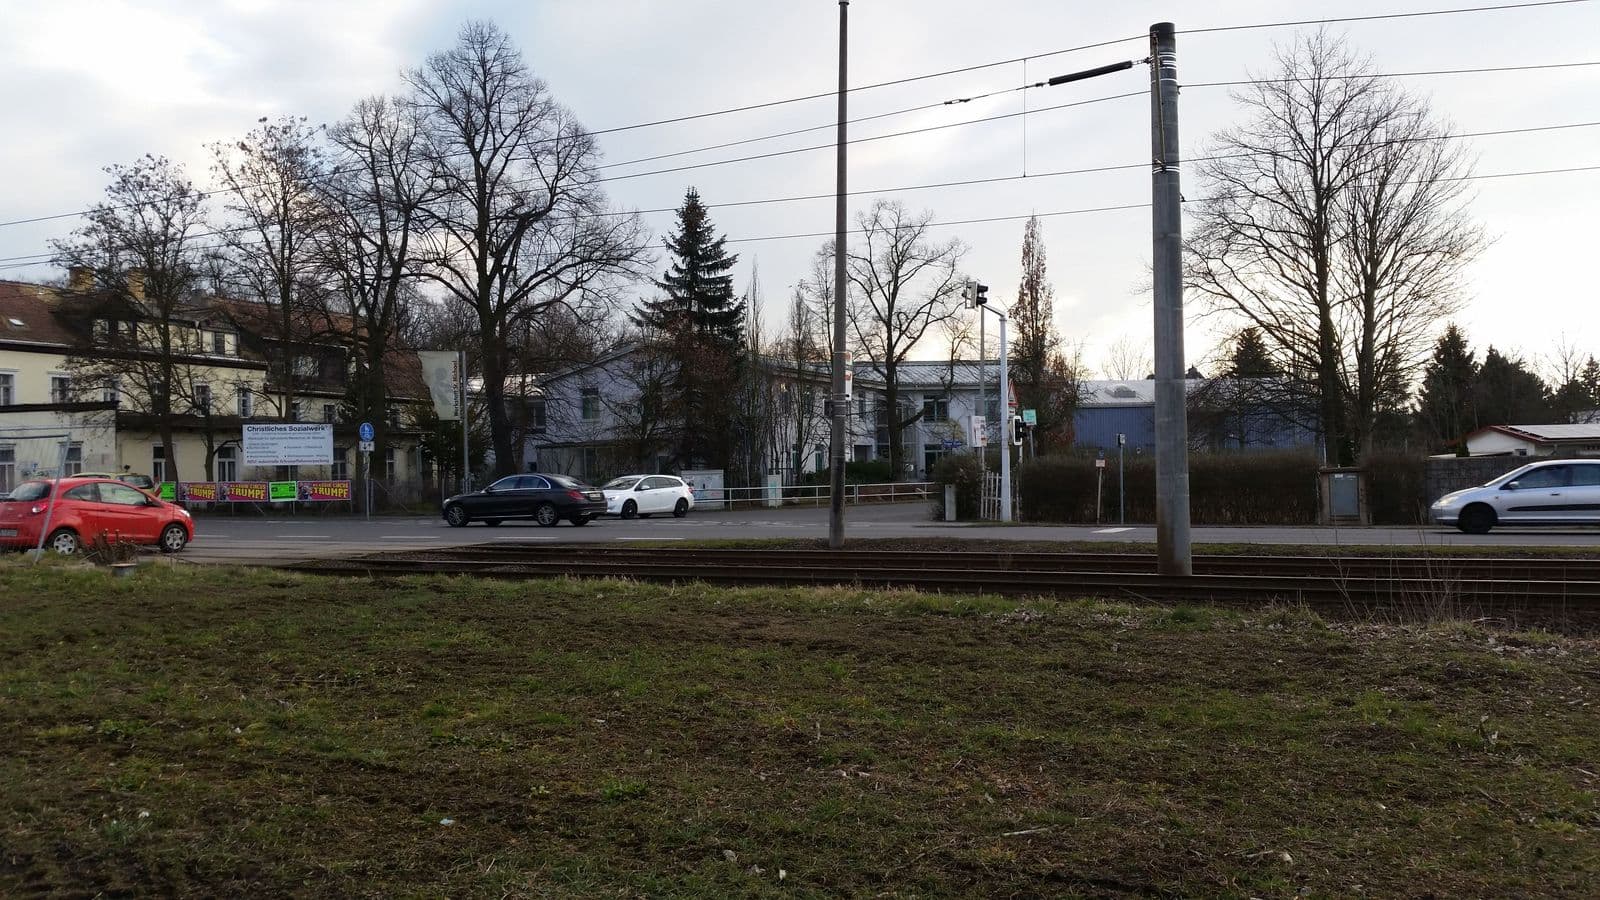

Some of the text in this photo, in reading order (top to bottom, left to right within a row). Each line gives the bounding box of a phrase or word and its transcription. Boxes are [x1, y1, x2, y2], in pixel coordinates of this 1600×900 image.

[189, 487, 216, 500] TRUMPF
[231, 487, 266, 500] TRUMPF
[313, 486, 349, 498] TRUMPF
